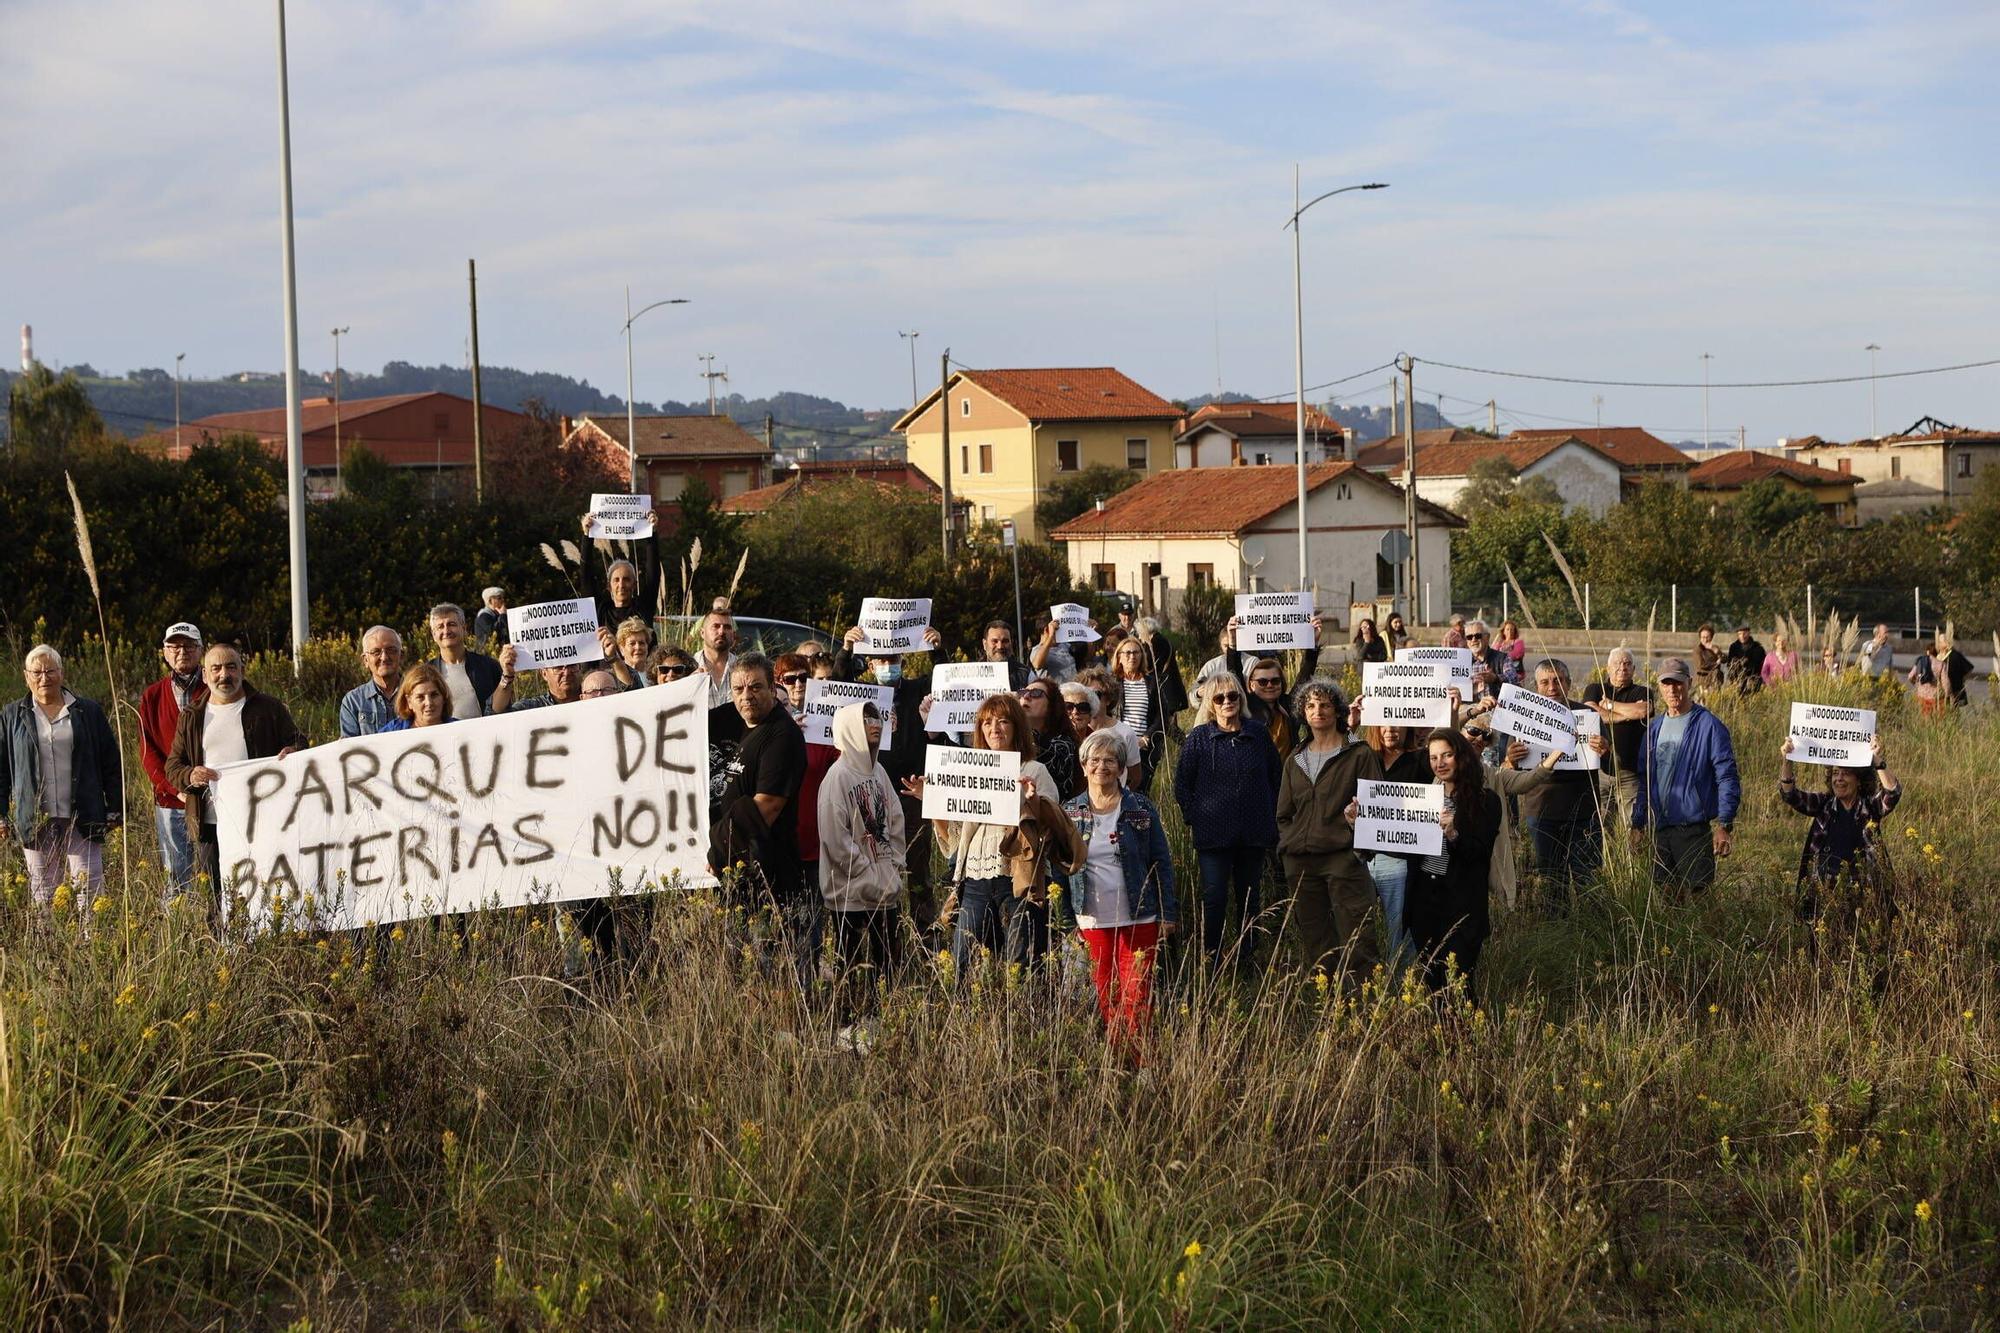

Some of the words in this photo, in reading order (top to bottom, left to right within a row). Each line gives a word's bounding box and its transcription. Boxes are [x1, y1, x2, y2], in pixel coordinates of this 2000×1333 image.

[598, 511, 618, 520] PARQUE
[619, 511, 626, 520] DE
[605, 526, 612, 534] EN
[613, 526, 635, 534] LLOREDA
[865, 619, 888, 630] PARQUE
[889, 620, 898, 630] DE
[1247, 614, 1272, 625] PARQUE
[1273, 614, 1281, 624] DE
[521, 626, 550, 642] PARQUE
[550, 625, 560, 638] DE
[1256, 633, 1265, 644] EN
[1266, 632, 1294, 644] LLOREDA
[873, 638, 882, 648] EN
[882, 637, 910, 648] LLOREDA
[534, 650, 544, 662] EN
[546, 645, 578, 660] LLOREDA
[941, 689, 965, 702] PARQUE
[967, 689, 974, 701] DE
[1365, 686, 1372, 697] AL
[1374, 686, 1401, 698] PARQUE
[1403, 686, 1412, 698] DE
[806, 702, 814, 714] AL
[816, 704, 840, 716] PARQ
[1384, 707, 1393, 718] EN
[1395, 707, 1425, 719] LLOREDA
[1499, 700, 1506, 708] AL
[1508, 702, 1535, 719] PARQUE
[1535, 712, 1545, 724] DE
[948, 712, 957, 724] EN
[824, 726, 834, 738] EN
[1513, 720, 1522, 732] EN
[1523, 724, 1552, 742] LLOREDA
[1792, 724, 1800, 736] AL
[1801, 726, 1827, 739] PARQUE
[1829, 729, 1838, 740] DE
[1808, 746, 1818, 757] EN
[1819, 747, 1848, 760] LLOREDA
[246, 725, 571, 844] PARQUE
[615, 704, 696, 782] DE
[926, 772, 935, 785] AL
[937, 773, 966, 788] PARQUE
[968, 776, 978, 789] DE
[947, 798, 957, 813] EN
[959, 799, 992, 815] LLOREDA
[1358, 804, 1366, 818] AL
[1368, 806, 1394, 820] PARQUE
[1396, 808, 1405, 821] DE
[591, 789, 698, 857] NO!!
[1376, 830, 1386, 842] EN
[1388, 830, 1418, 845] LLOREDA
